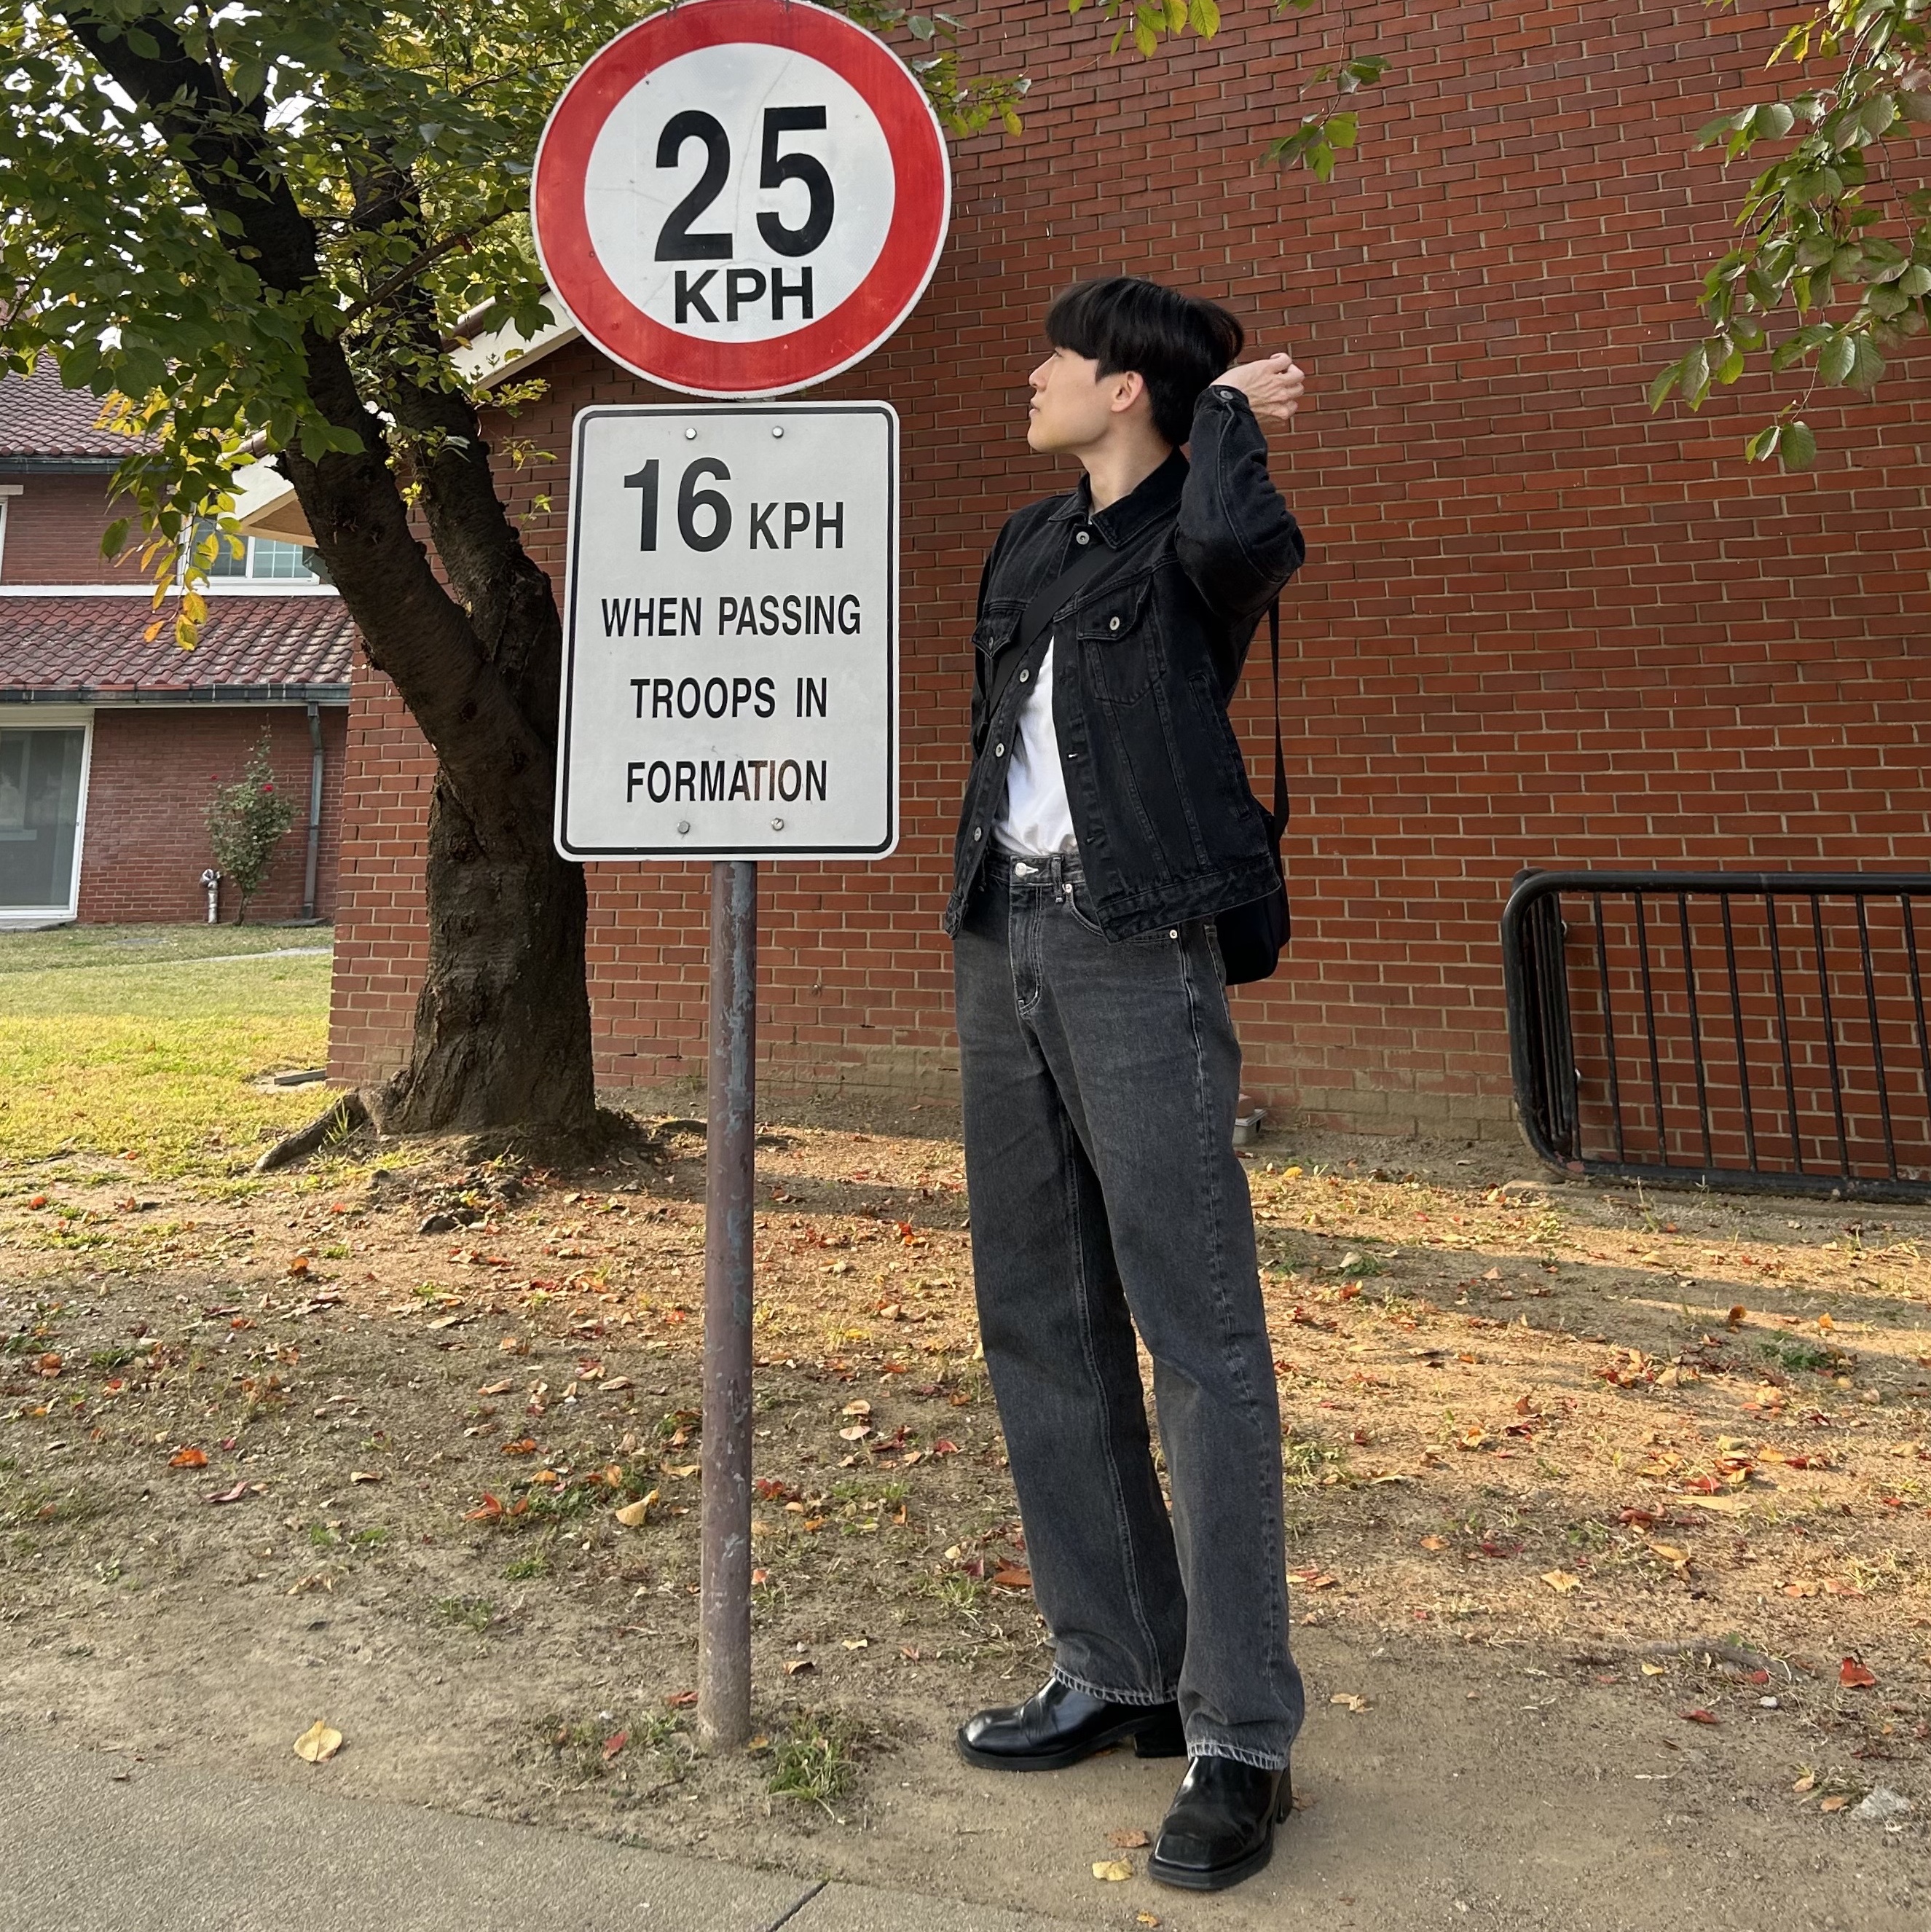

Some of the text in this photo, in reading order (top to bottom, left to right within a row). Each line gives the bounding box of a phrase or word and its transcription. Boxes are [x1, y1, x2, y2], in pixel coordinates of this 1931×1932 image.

[654, 105, 835, 262] 25
[675, 266, 814, 324] KPH
[624, 457, 843, 552] 16 KPH
[601, 594, 860, 637] WHEN PASSING
[630, 677, 827, 719] TROOPS IN
[626, 759, 827, 804] FORMATION
